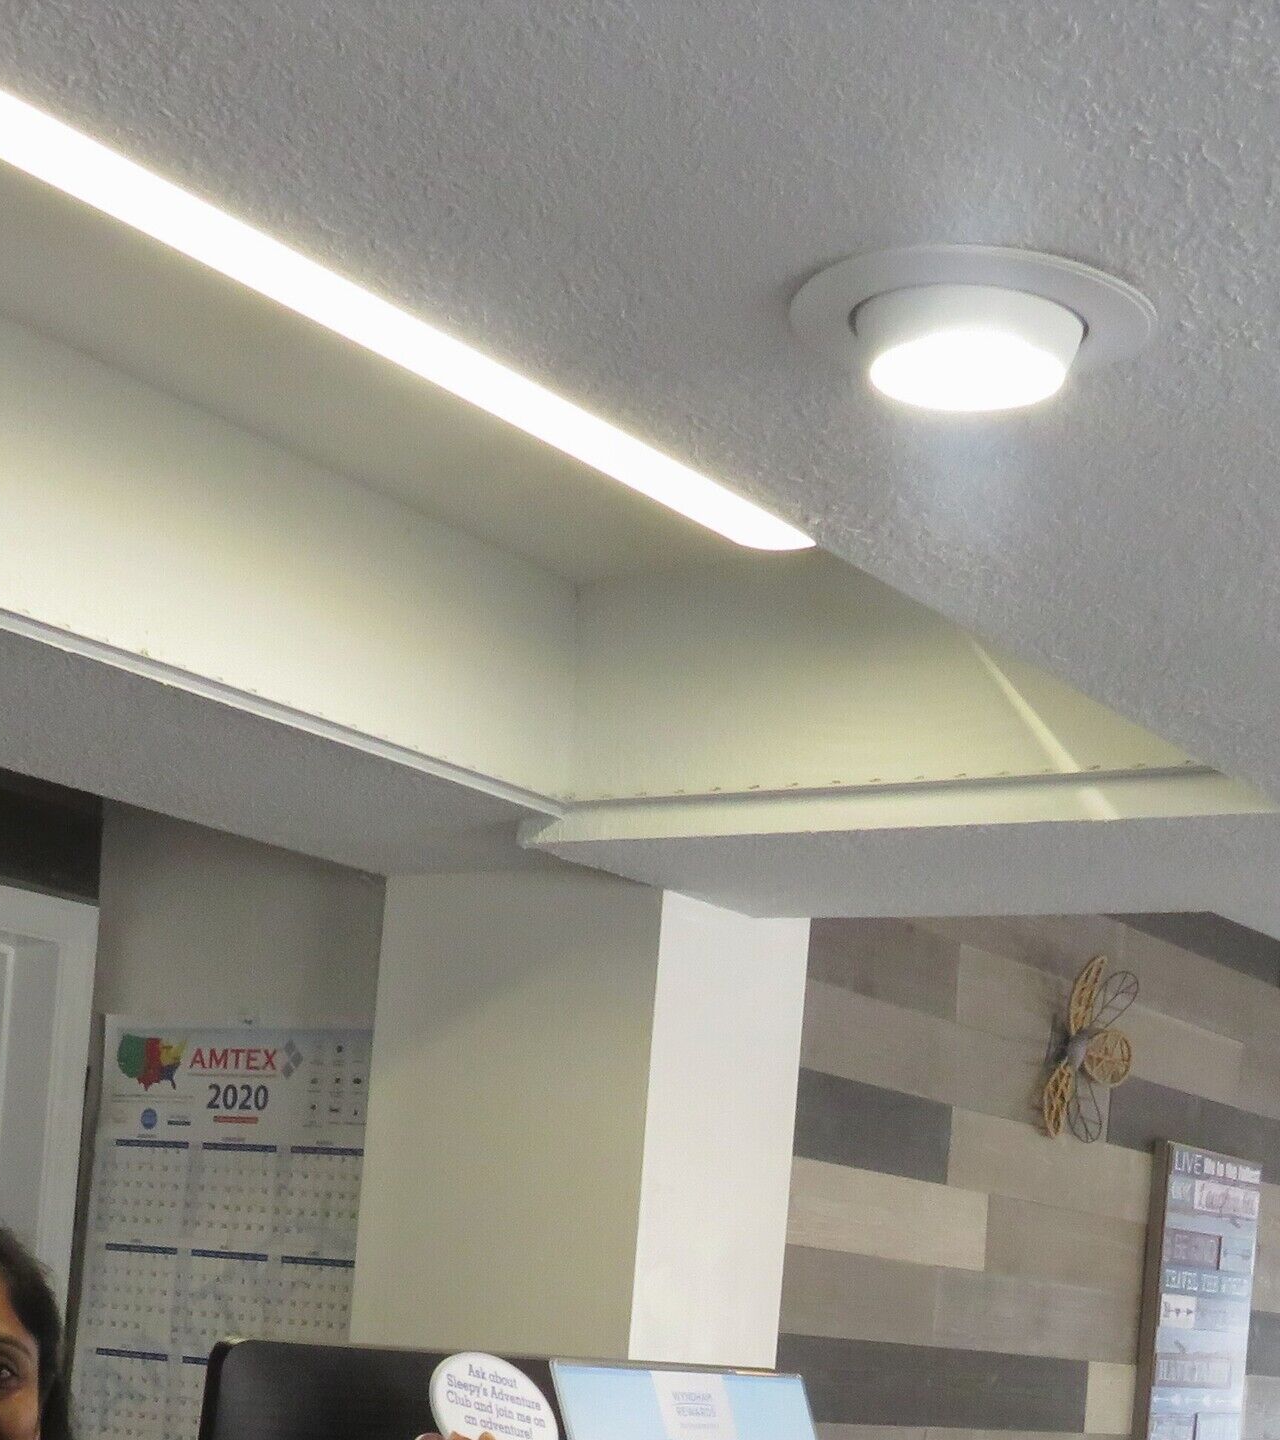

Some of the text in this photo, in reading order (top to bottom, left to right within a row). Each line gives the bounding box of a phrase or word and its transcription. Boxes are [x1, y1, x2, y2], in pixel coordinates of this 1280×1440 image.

[189, 1047, 278, 1071] AMTEX
[206, 1083, 269, 1110] 2020
[468, 1363, 517, 1388] Ask about
[446, 1373, 542, 1411] Sleepy's Adventure
[446, 1390, 546, 1428] Club and join me on
[464, 1415, 534, 1440] an adventure!
